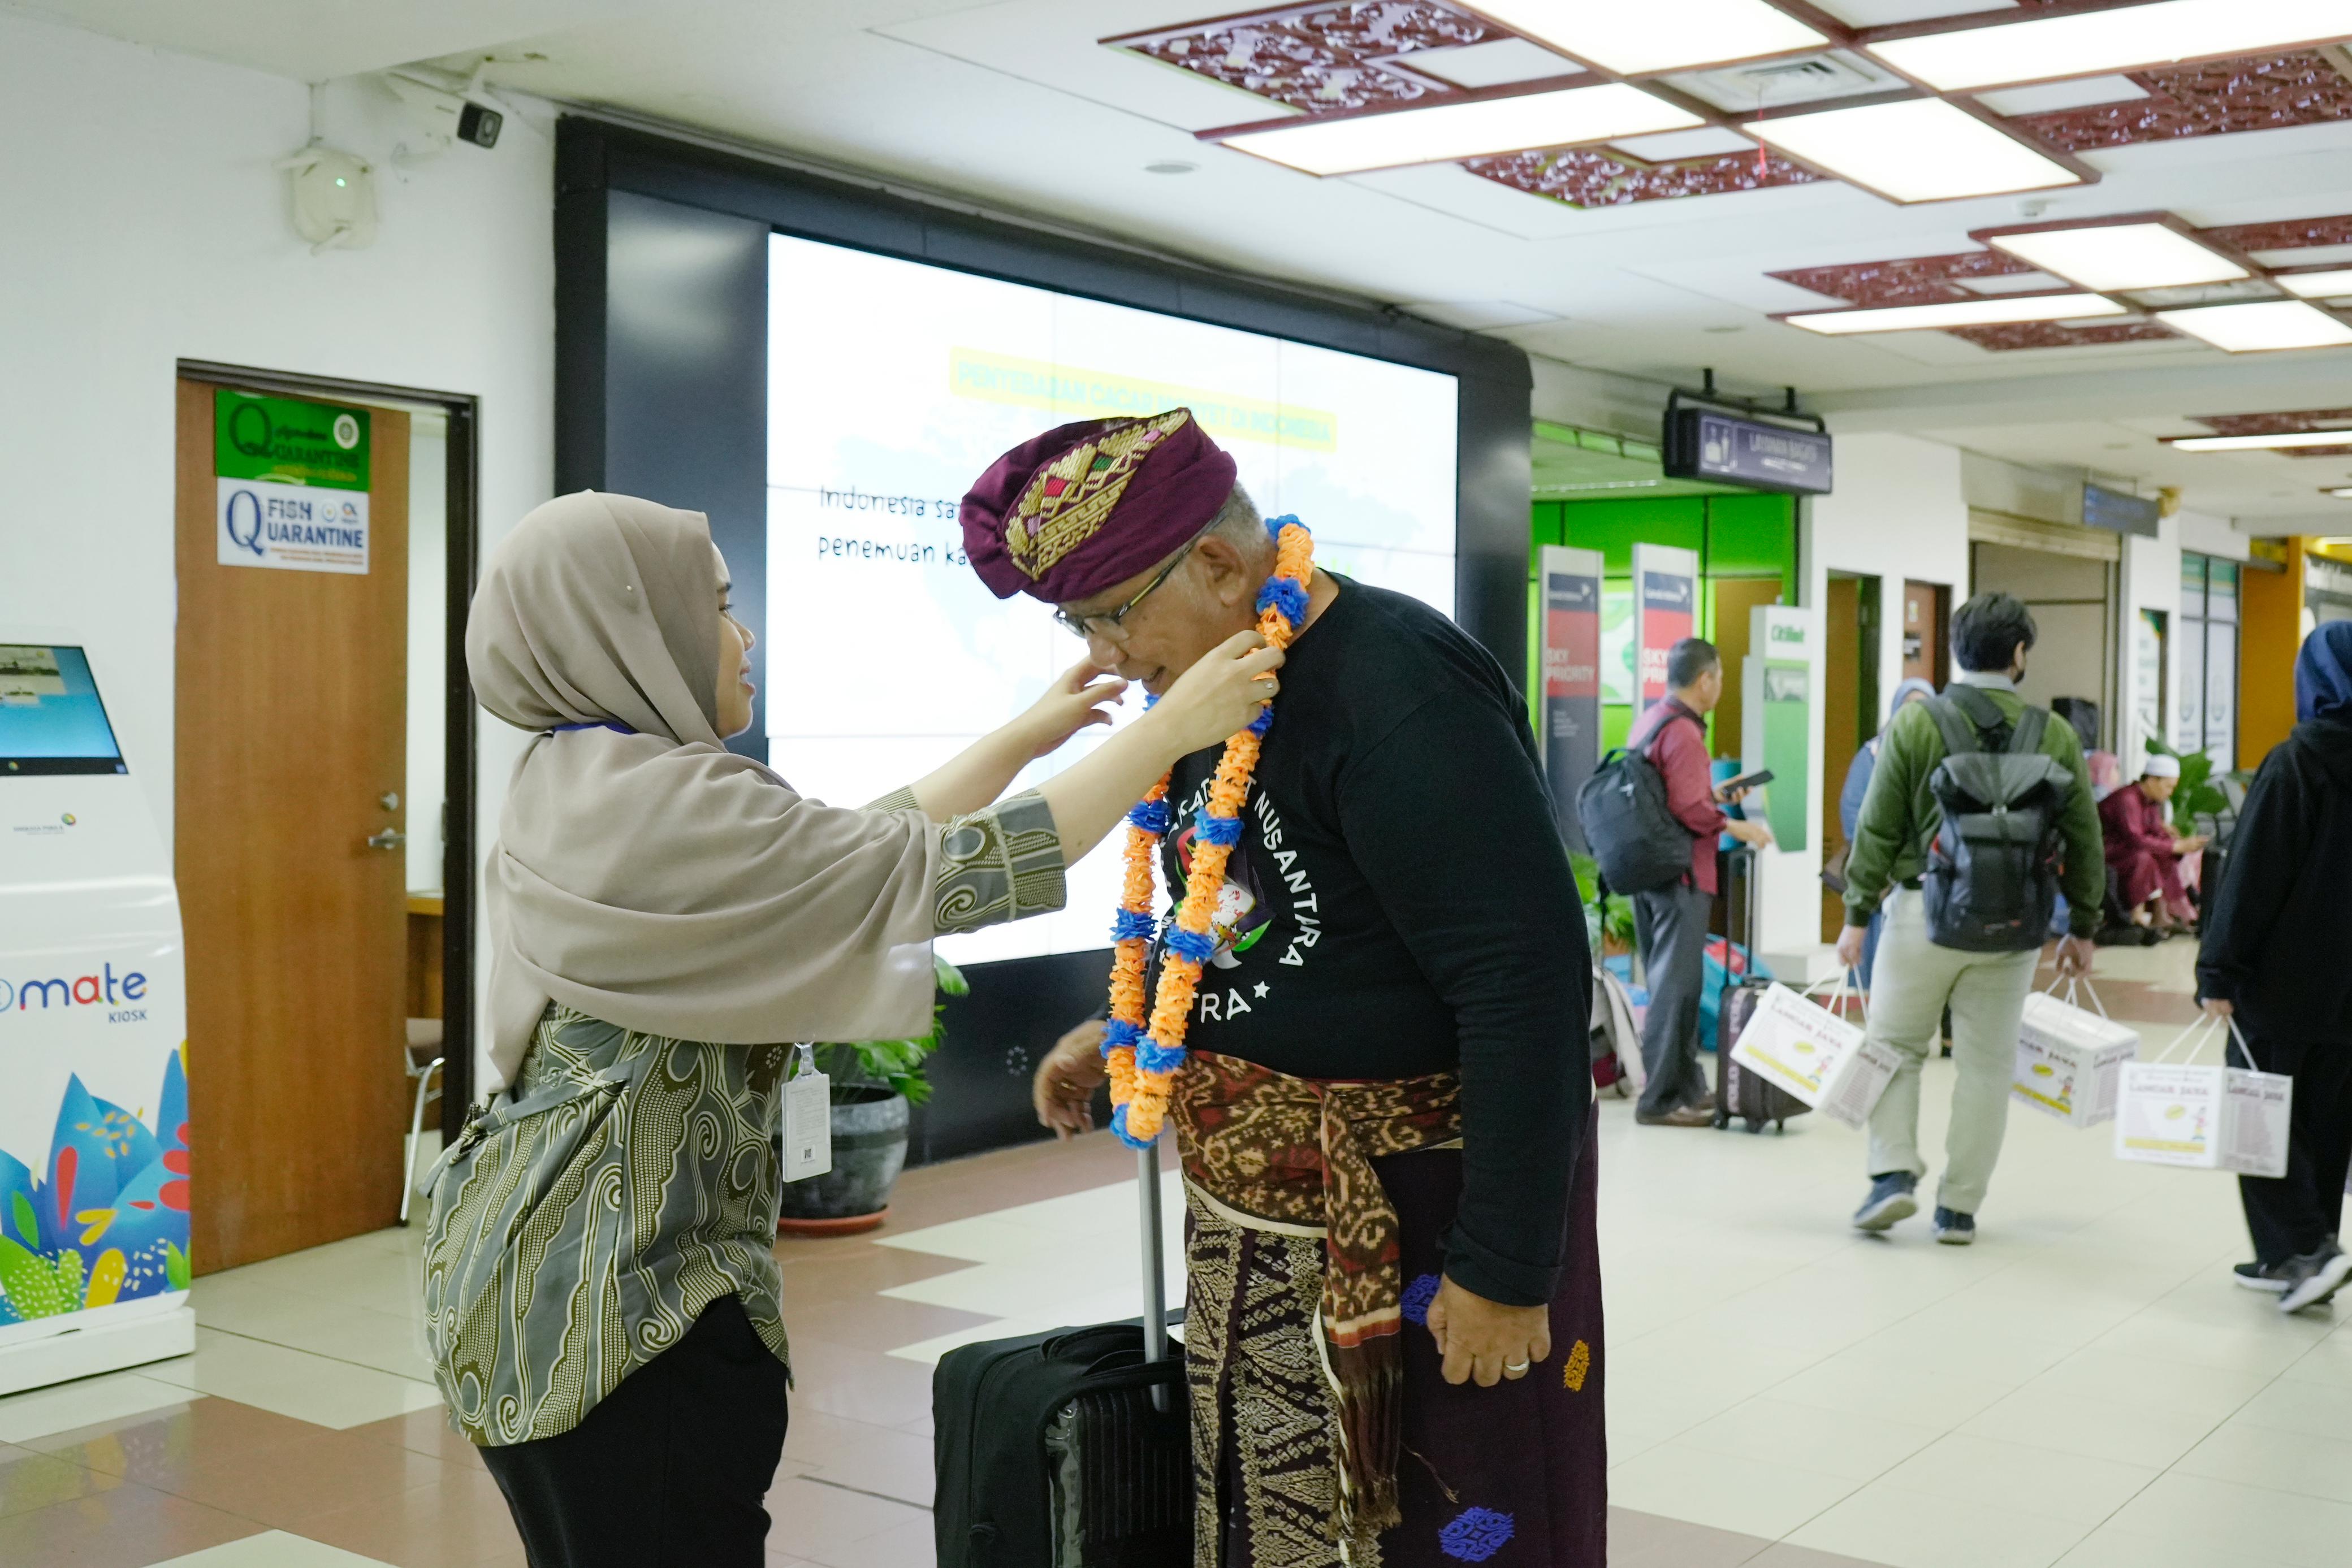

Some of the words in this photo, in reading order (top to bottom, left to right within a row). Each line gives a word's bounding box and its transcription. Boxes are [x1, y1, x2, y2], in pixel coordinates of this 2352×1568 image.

[267, 498, 312, 521] FISH
[820, 485, 924, 516] Indonesia
[227, 490, 264, 556] Q
[819, 536, 935, 563] penemuan
[109, 1009, 148, 1024] KIOSK
[1193, 987, 1252, 1023] RA
